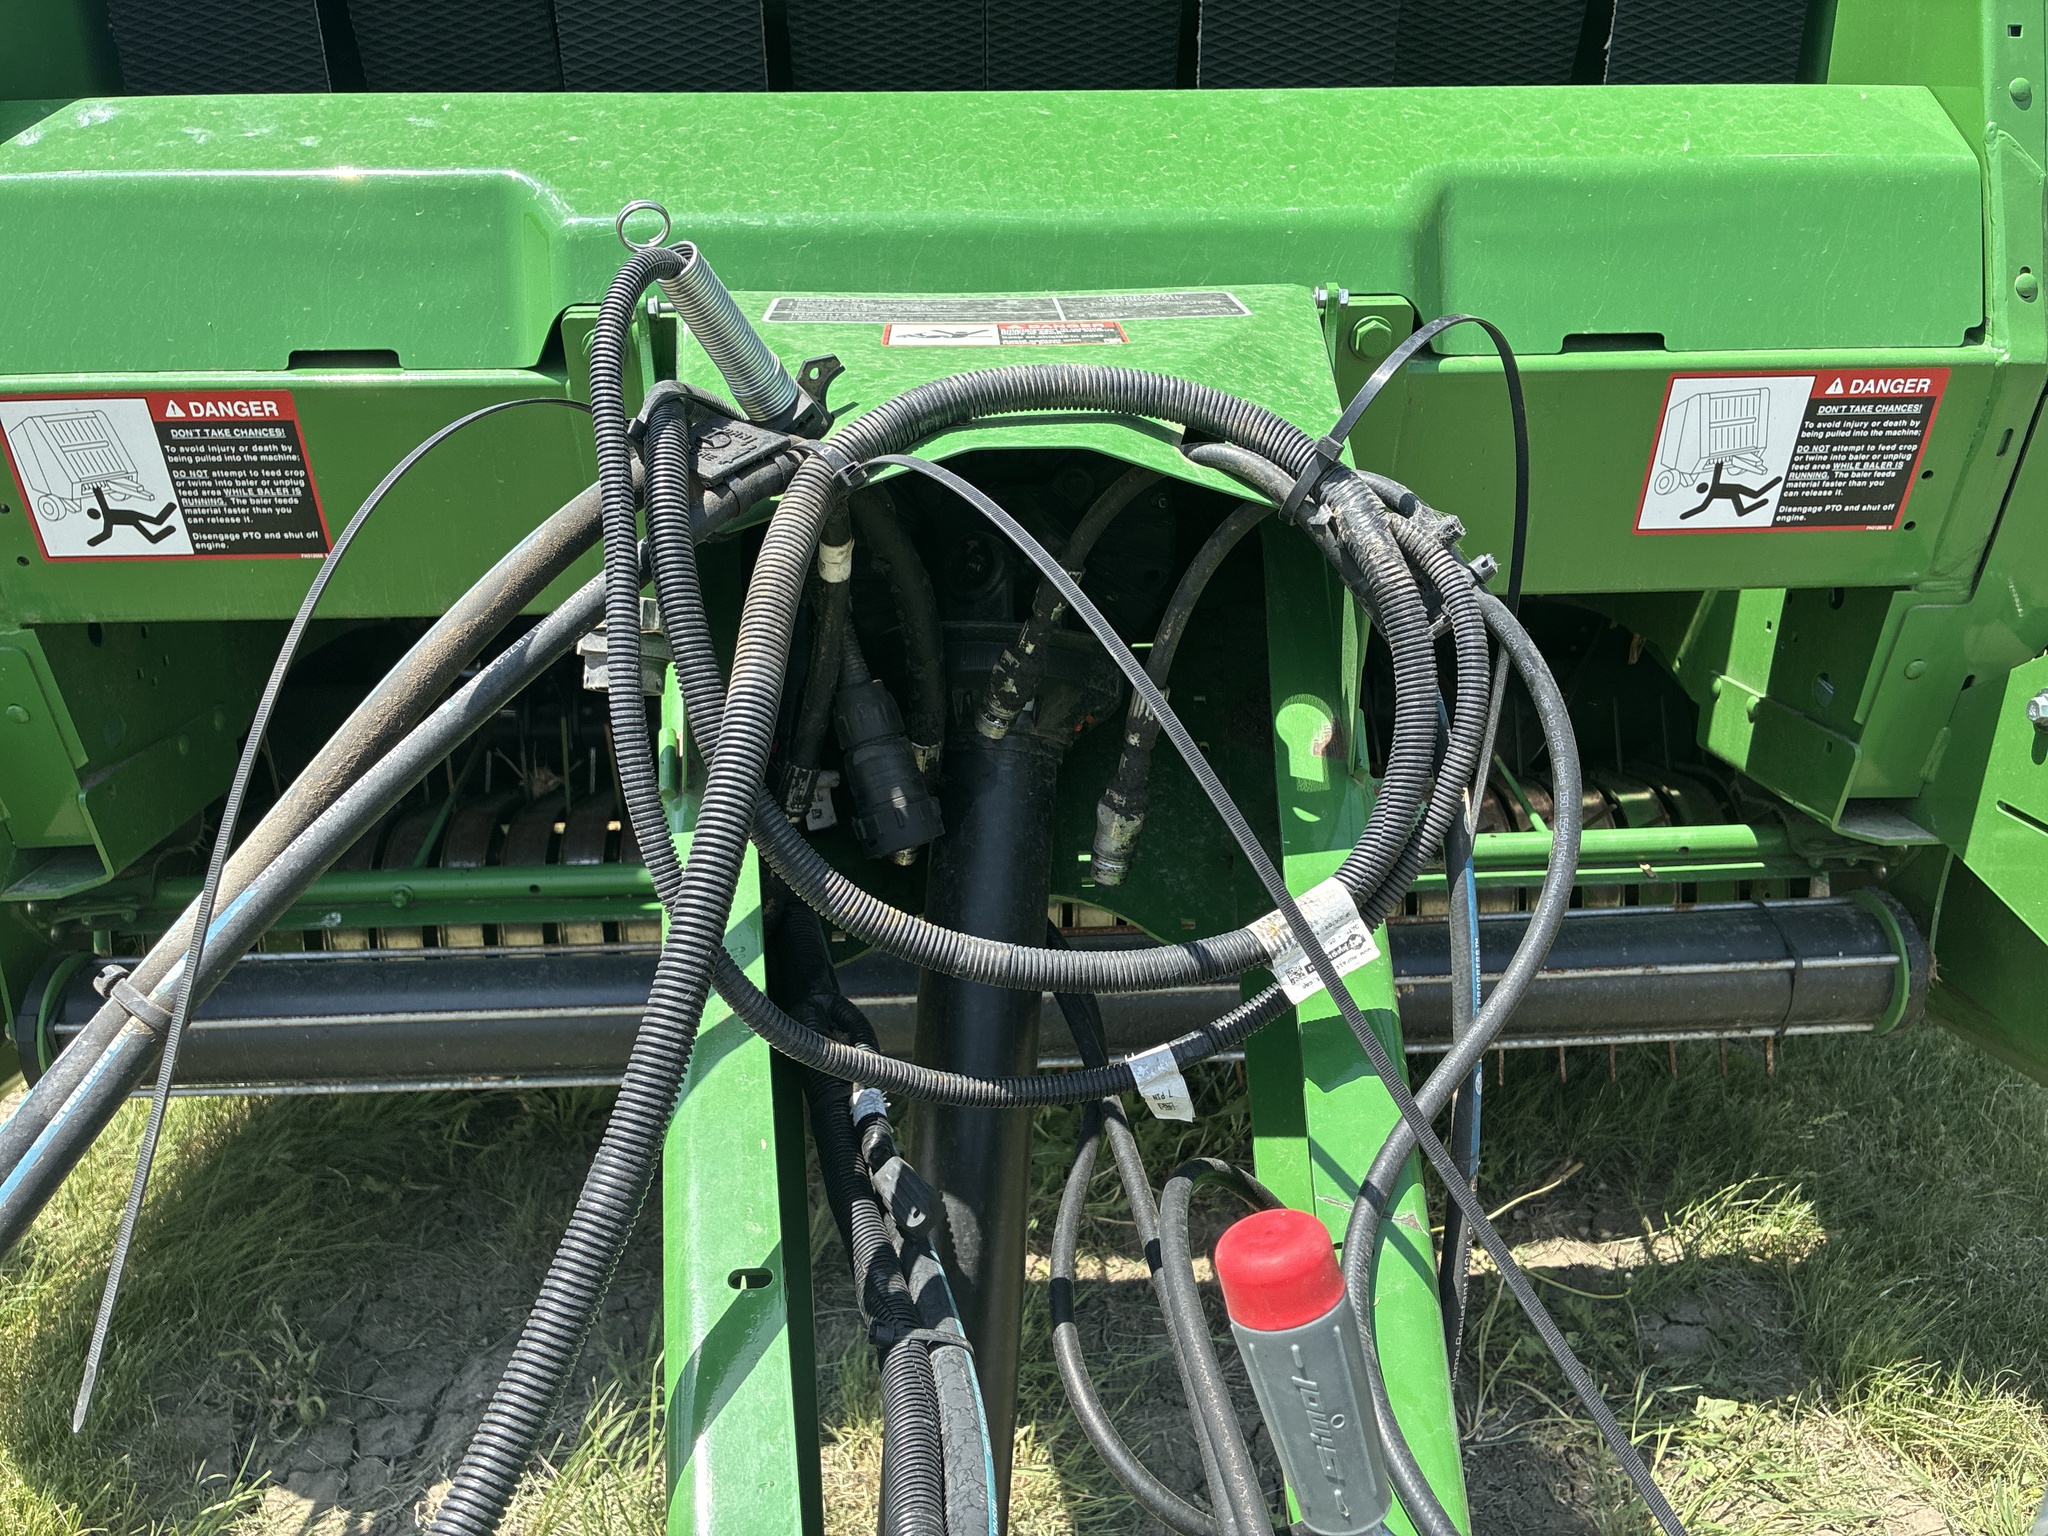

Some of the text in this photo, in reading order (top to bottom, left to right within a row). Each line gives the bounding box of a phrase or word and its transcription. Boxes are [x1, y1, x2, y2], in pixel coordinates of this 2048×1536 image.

[1849, 379, 1931, 394] DANGER
[189, 401, 279, 417] DANGER
[1818, 404, 1923, 414] DON'T TAKE CHANCES!
[1843, 420, 1869, 430] injury
[1910, 420, 1920, 428] by
[171, 428, 286, 438] DON'T TAKE CHANCES!
[1801, 431, 1823, 439] being
[1825, 430, 1850, 439] pulled
[1885, 429, 1921, 437] machine;
[208, 445, 235, 454] injury
[252, 444, 278, 452] death
[282, 444, 292, 453] by
[1812, 445, 1830, 453] NOT
[1832, 445, 1865, 453] attempt
[1899, 445, 1917, 453] crop
[168, 455, 193, 464] being
[195, 455, 222, 464] pulled
[1883, 453, 1912, 461] unplug
[1832, 462, 1860, 470] WHILE
[173, 470, 186, 478] DO
[191, 470, 209, 478] NOT
[212, 470, 246, 479] attempt
[261, 469, 281, 477] feed
[285, 470, 305, 479] crop
[1789, 472, 1829, 480] RUNNING.
[273, 479, 305, 487] unplug
[1869, 480, 1885, 488] you
[224, 488, 254, 496] WHILE
[257, 488, 289, 496] BALER
[292, 487, 301, 495] IS
[181, 498, 227, 506] RUNNING.
[185, 507, 221, 515] material
[275, 507, 292, 515] you
[1779, 506, 1822, 514] Disengage
[1776, 515, 1806, 523] engine.
[192, 533, 240, 541] Disengage
[196, 542, 229, 550] engine.
[1521, 659, 1535, 675] 207
[1547, 713, 1556, 726] to
[1551, 730, 1565, 752] 212F
[1554, 756, 1567, 785] Meets
[1559, 790, 1569, 807] ISO
[1152, 1092, 1166, 1101] PIN
